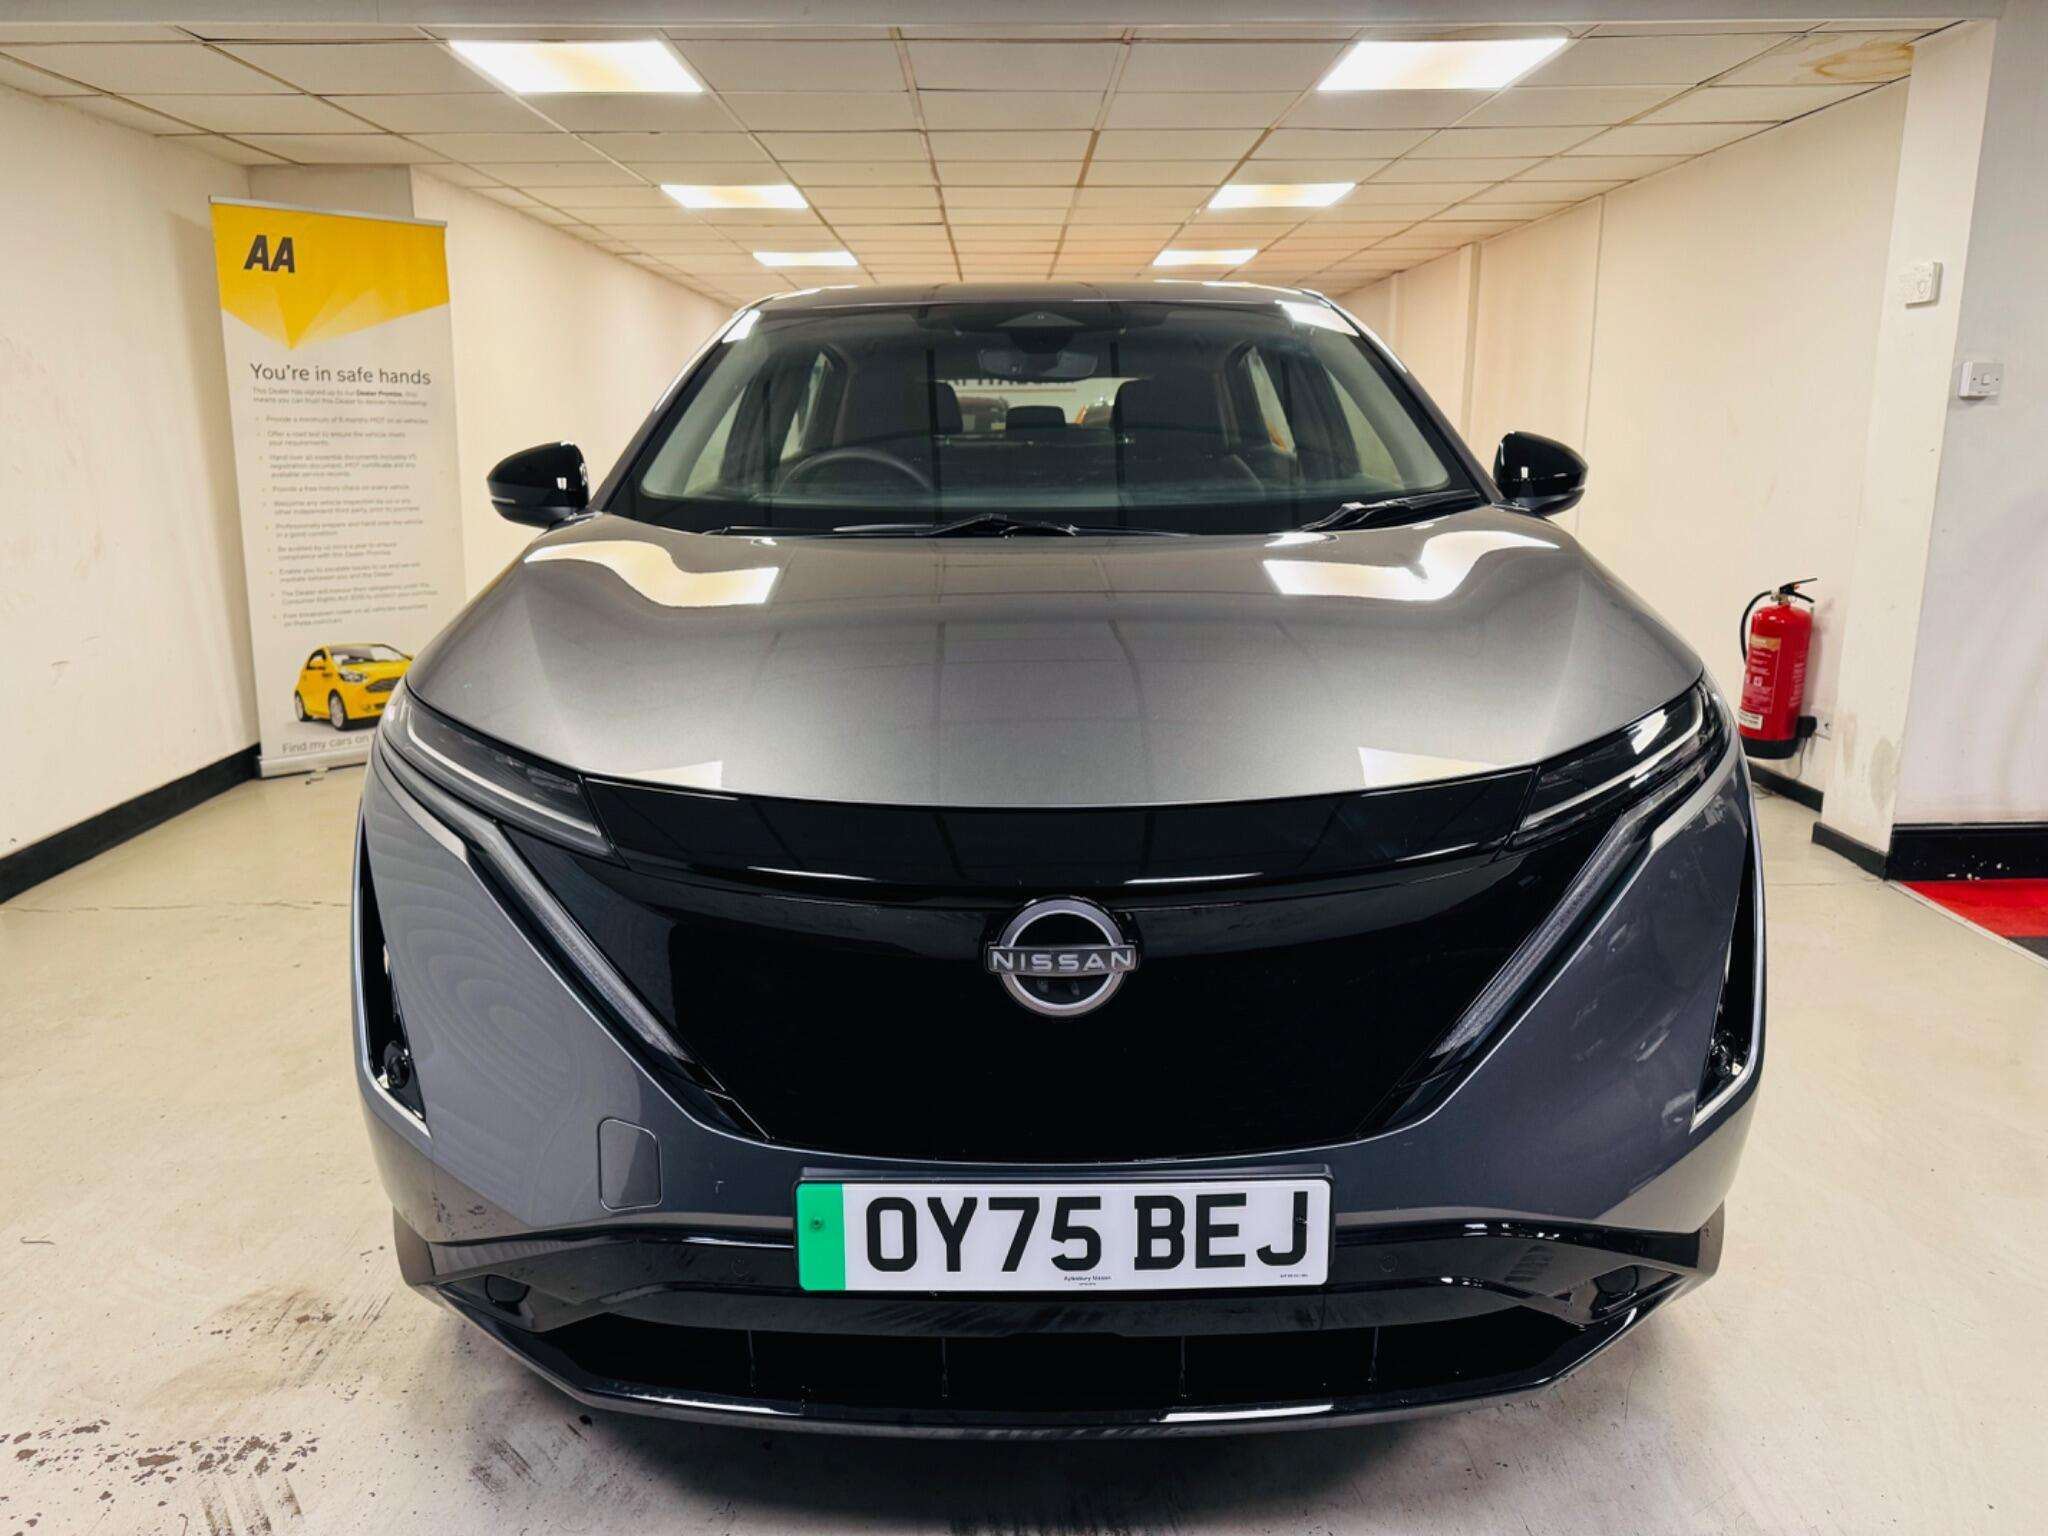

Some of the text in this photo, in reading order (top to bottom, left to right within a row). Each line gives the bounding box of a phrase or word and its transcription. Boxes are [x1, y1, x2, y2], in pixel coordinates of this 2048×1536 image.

[244, 234, 295, 273] AA
[250, 363, 431, 386] You're in safe hands
[282, 743, 307, 754] Find
[309, 740, 326, 750] my
[328, 737, 351, 749] cars
[354, 735, 369, 744] on
[992, 951, 1132, 971] NISSAN
[866, 1191, 1309, 1272] OY75 BEJ
